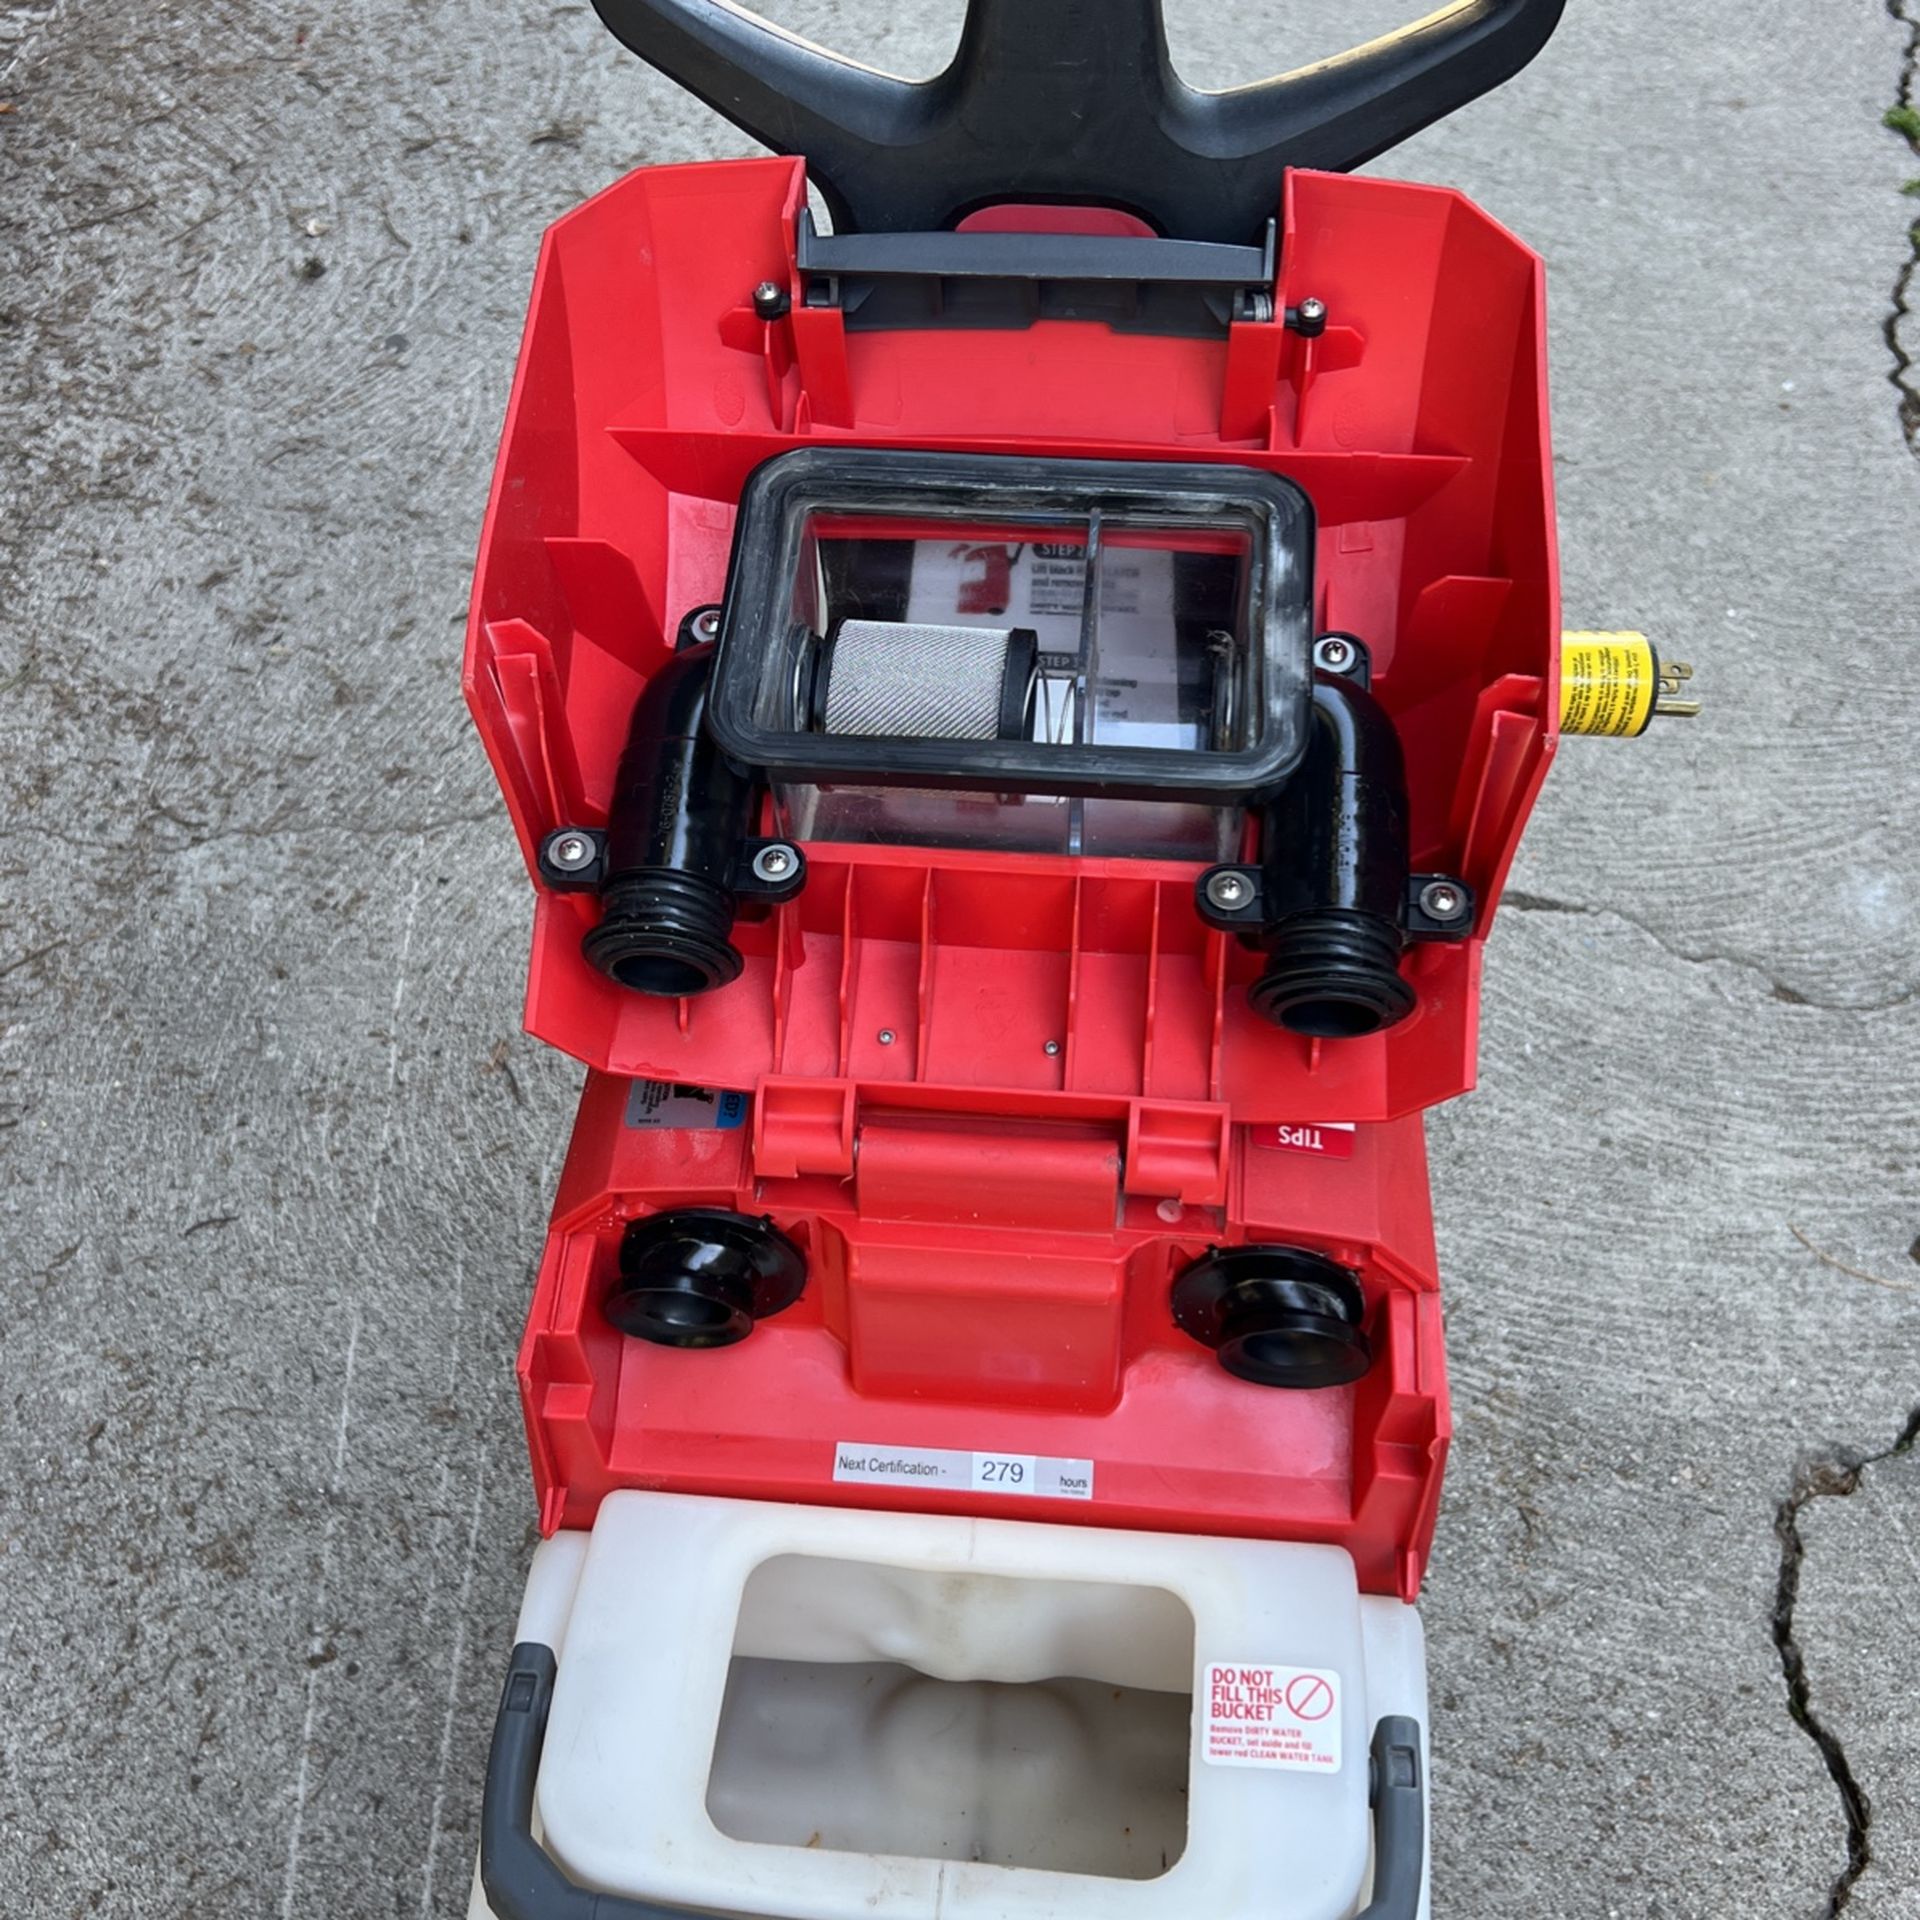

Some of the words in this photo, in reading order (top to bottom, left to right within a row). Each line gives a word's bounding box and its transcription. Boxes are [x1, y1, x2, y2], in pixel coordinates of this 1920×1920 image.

[1041, 544, 1074, 556] STEP
[1038, 655, 1070, 667] STEP
[1278, 1125, 1324, 1150] TIPS
[838, 1455, 866, 1471] Next
[869, 1457, 939, 1476] Certification
[982, 1460, 1024, 1483] 279
[1060, 1475, 1088, 1488] hours
[1211, 1668, 1236, 1684] DO
[1240, 1669, 1274, 1687] NOT
[1211, 1685, 1243, 1702] FILL
[1247, 1687, 1283, 1705] THIS
[1211, 1702, 1274, 1721] BUCKET
[1210, 1724, 1243, 1735] Remove
[1245, 1726, 1270, 1736] DIRTY
[1272, 1728, 1302, 1738] WATER
[1209, 1747, 1232, 1756] lower
[1234, 1749, 1248, 1758] red
[1250, 1749, 1277, 1760] CLEAN
[1279, 1751, 1309, 1762] WATER
